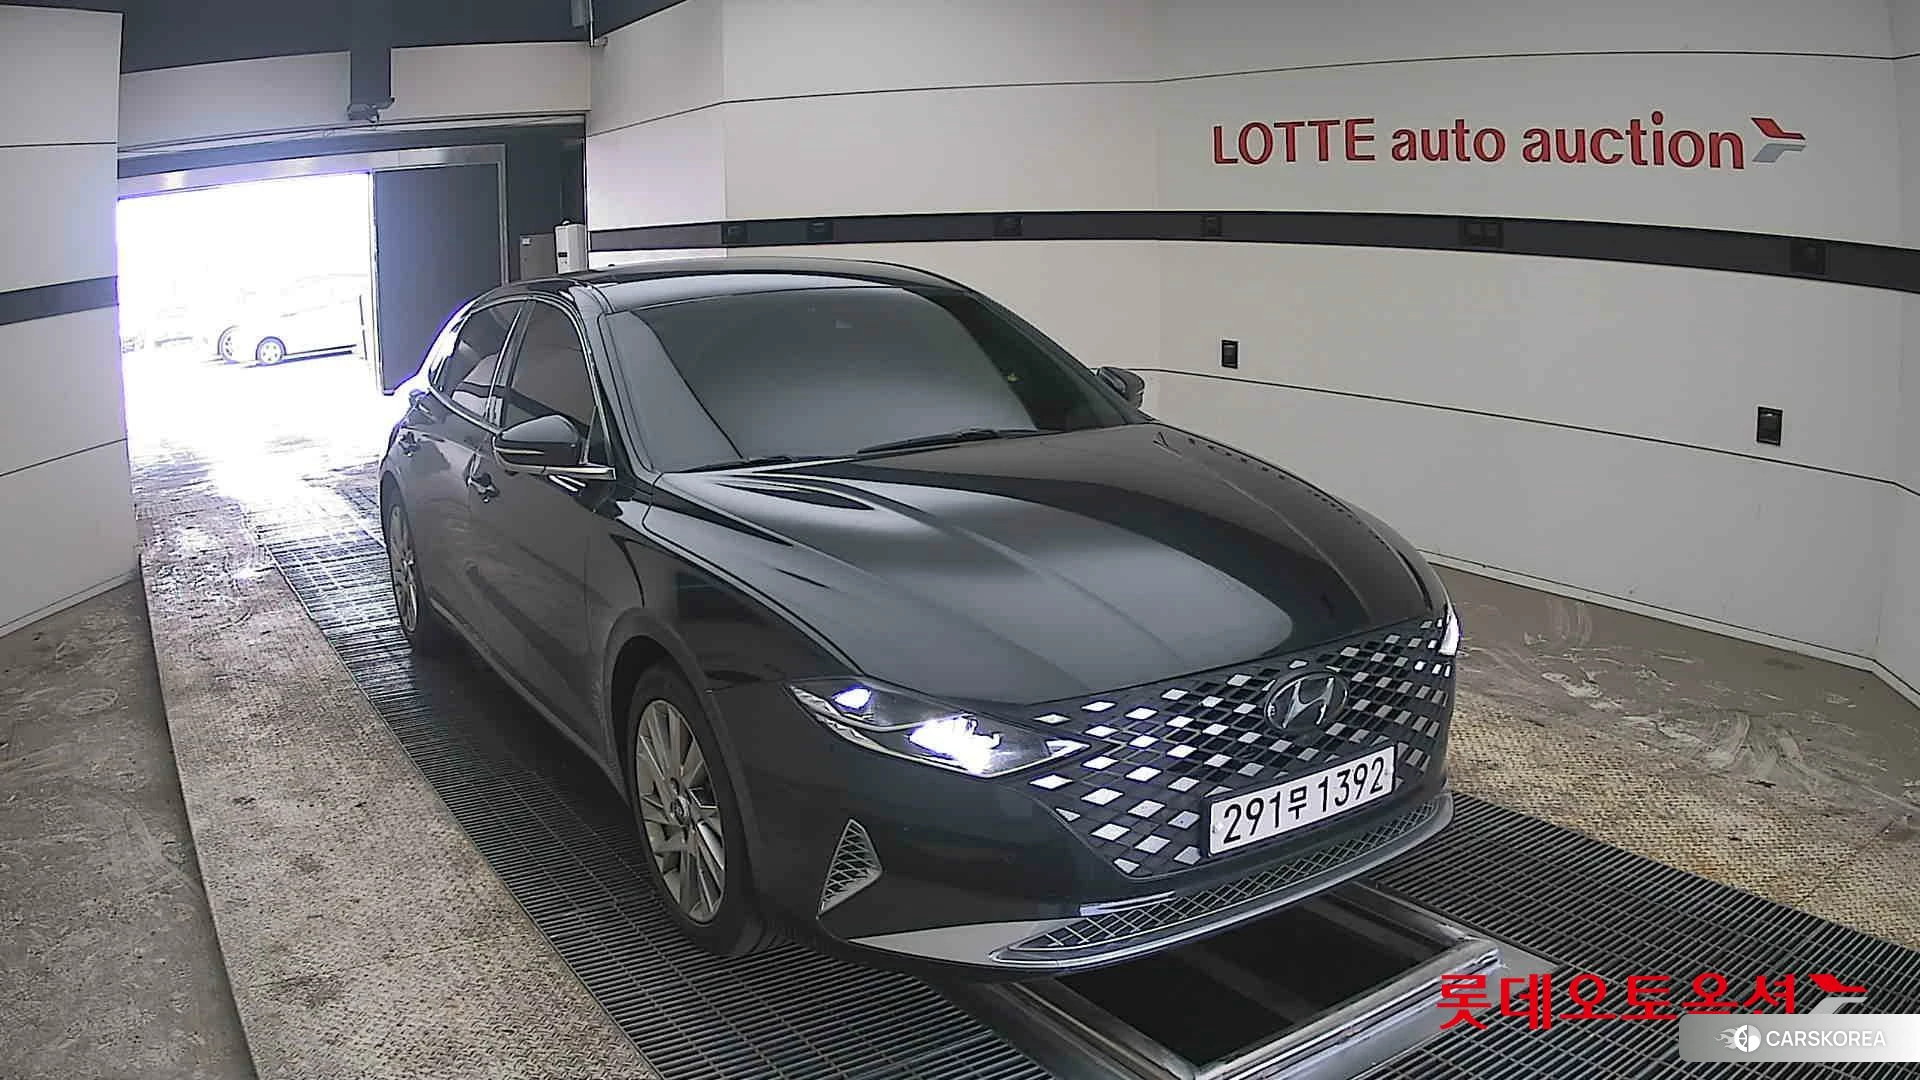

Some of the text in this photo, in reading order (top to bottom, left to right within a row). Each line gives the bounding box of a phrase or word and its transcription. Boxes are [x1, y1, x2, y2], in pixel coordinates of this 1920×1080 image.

[1213, 111, 1745, 170] LOTTE auto auction
